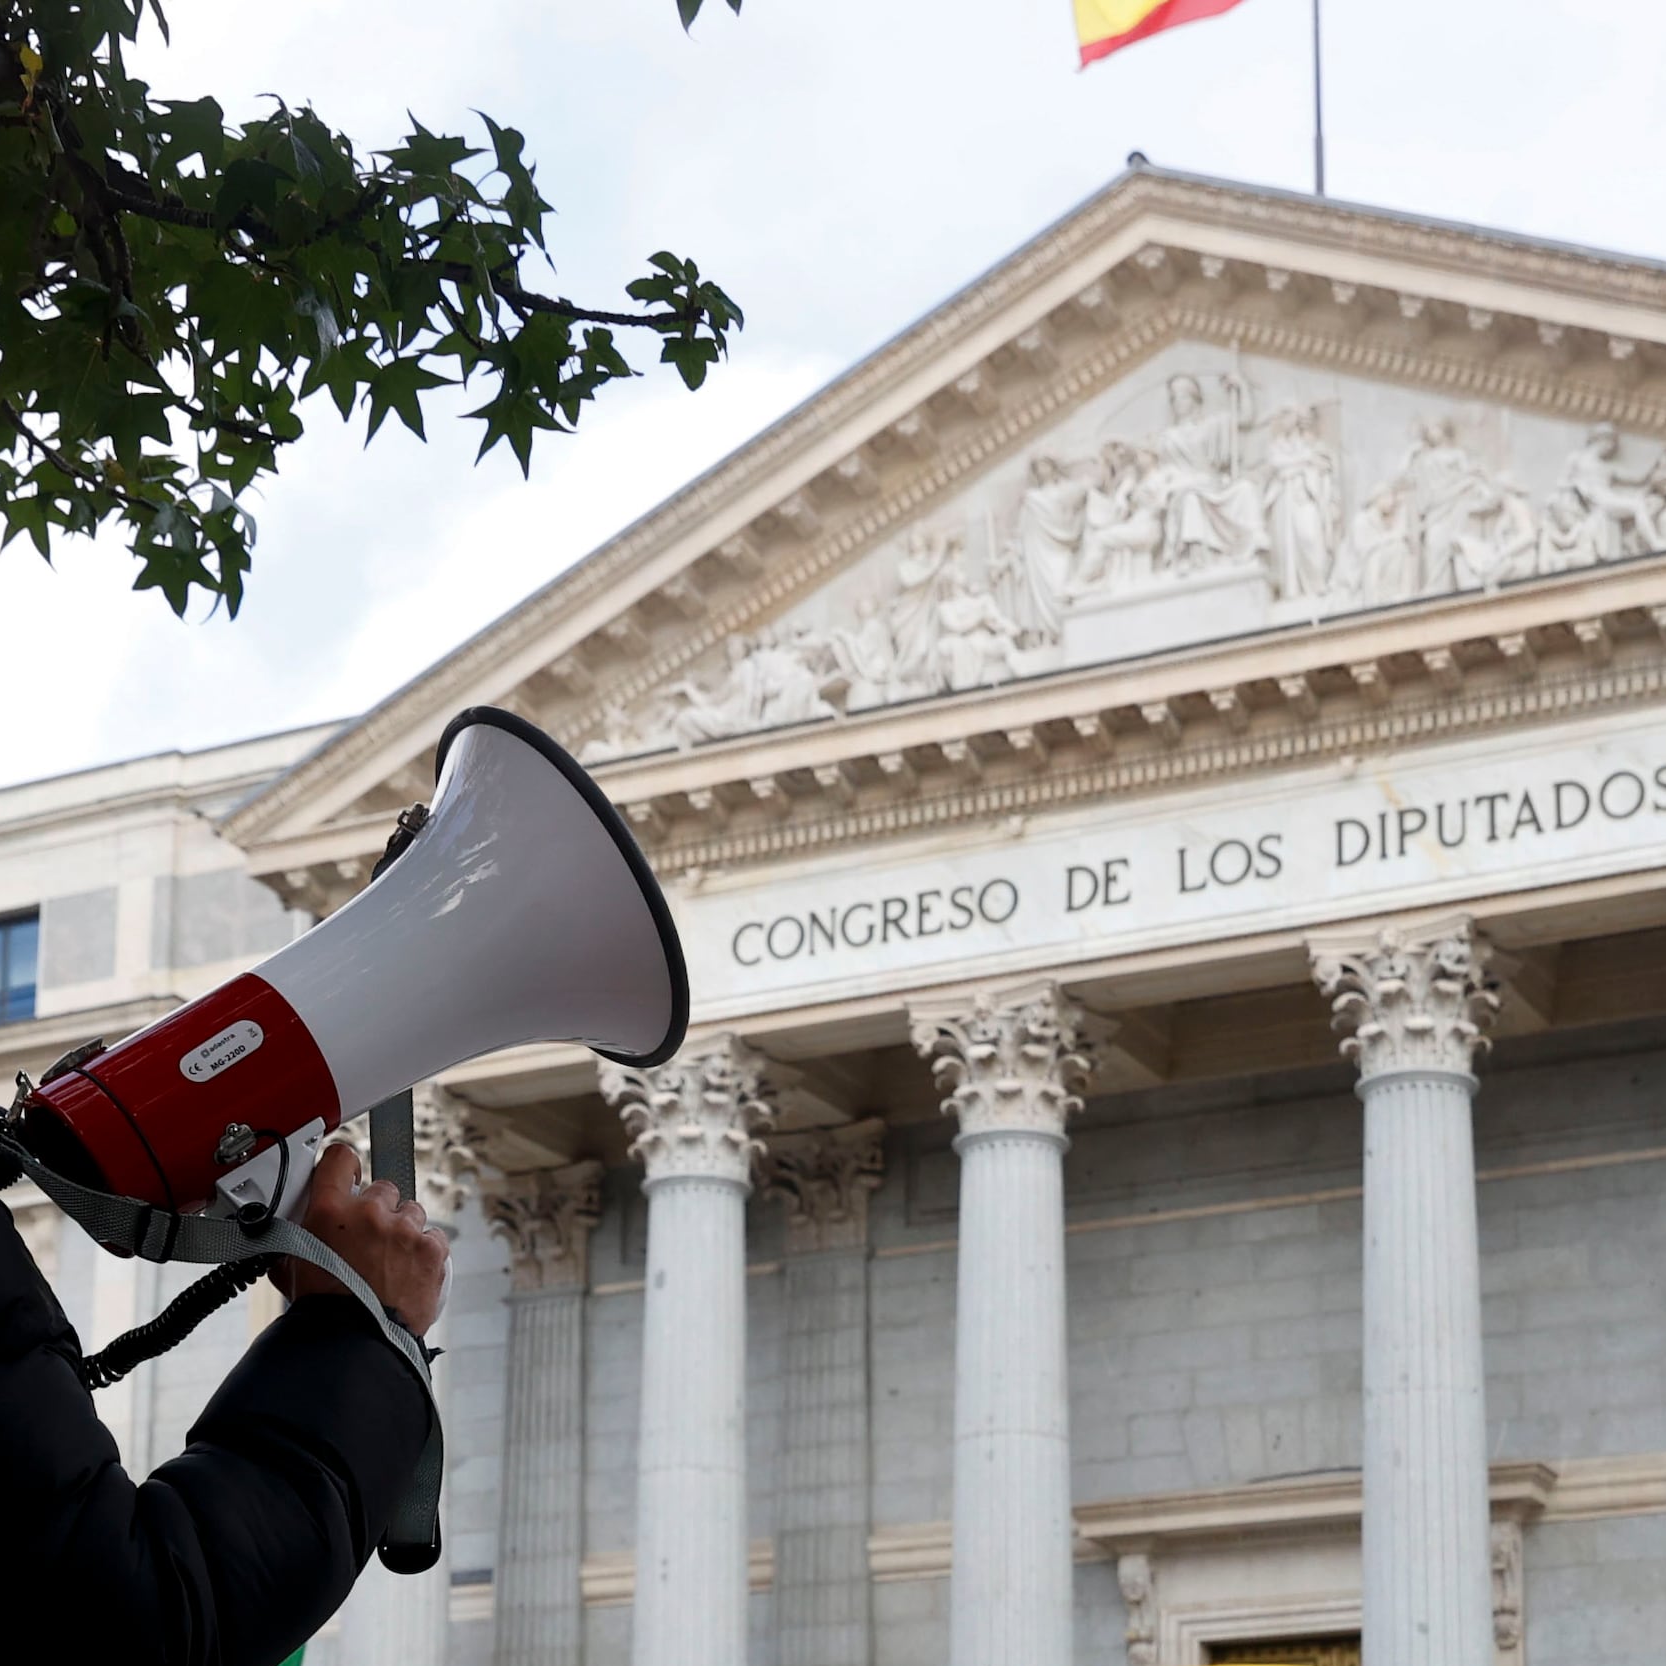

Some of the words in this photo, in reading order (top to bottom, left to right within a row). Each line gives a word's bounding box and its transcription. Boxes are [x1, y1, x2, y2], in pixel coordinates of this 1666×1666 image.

[731, 878, 1019, 966] CONGRESO
[1066, 857, 1131, 913] DE
[1178, 833, 1283, 894] LOS
[210, 1044, 246, 1071] MG-220D
